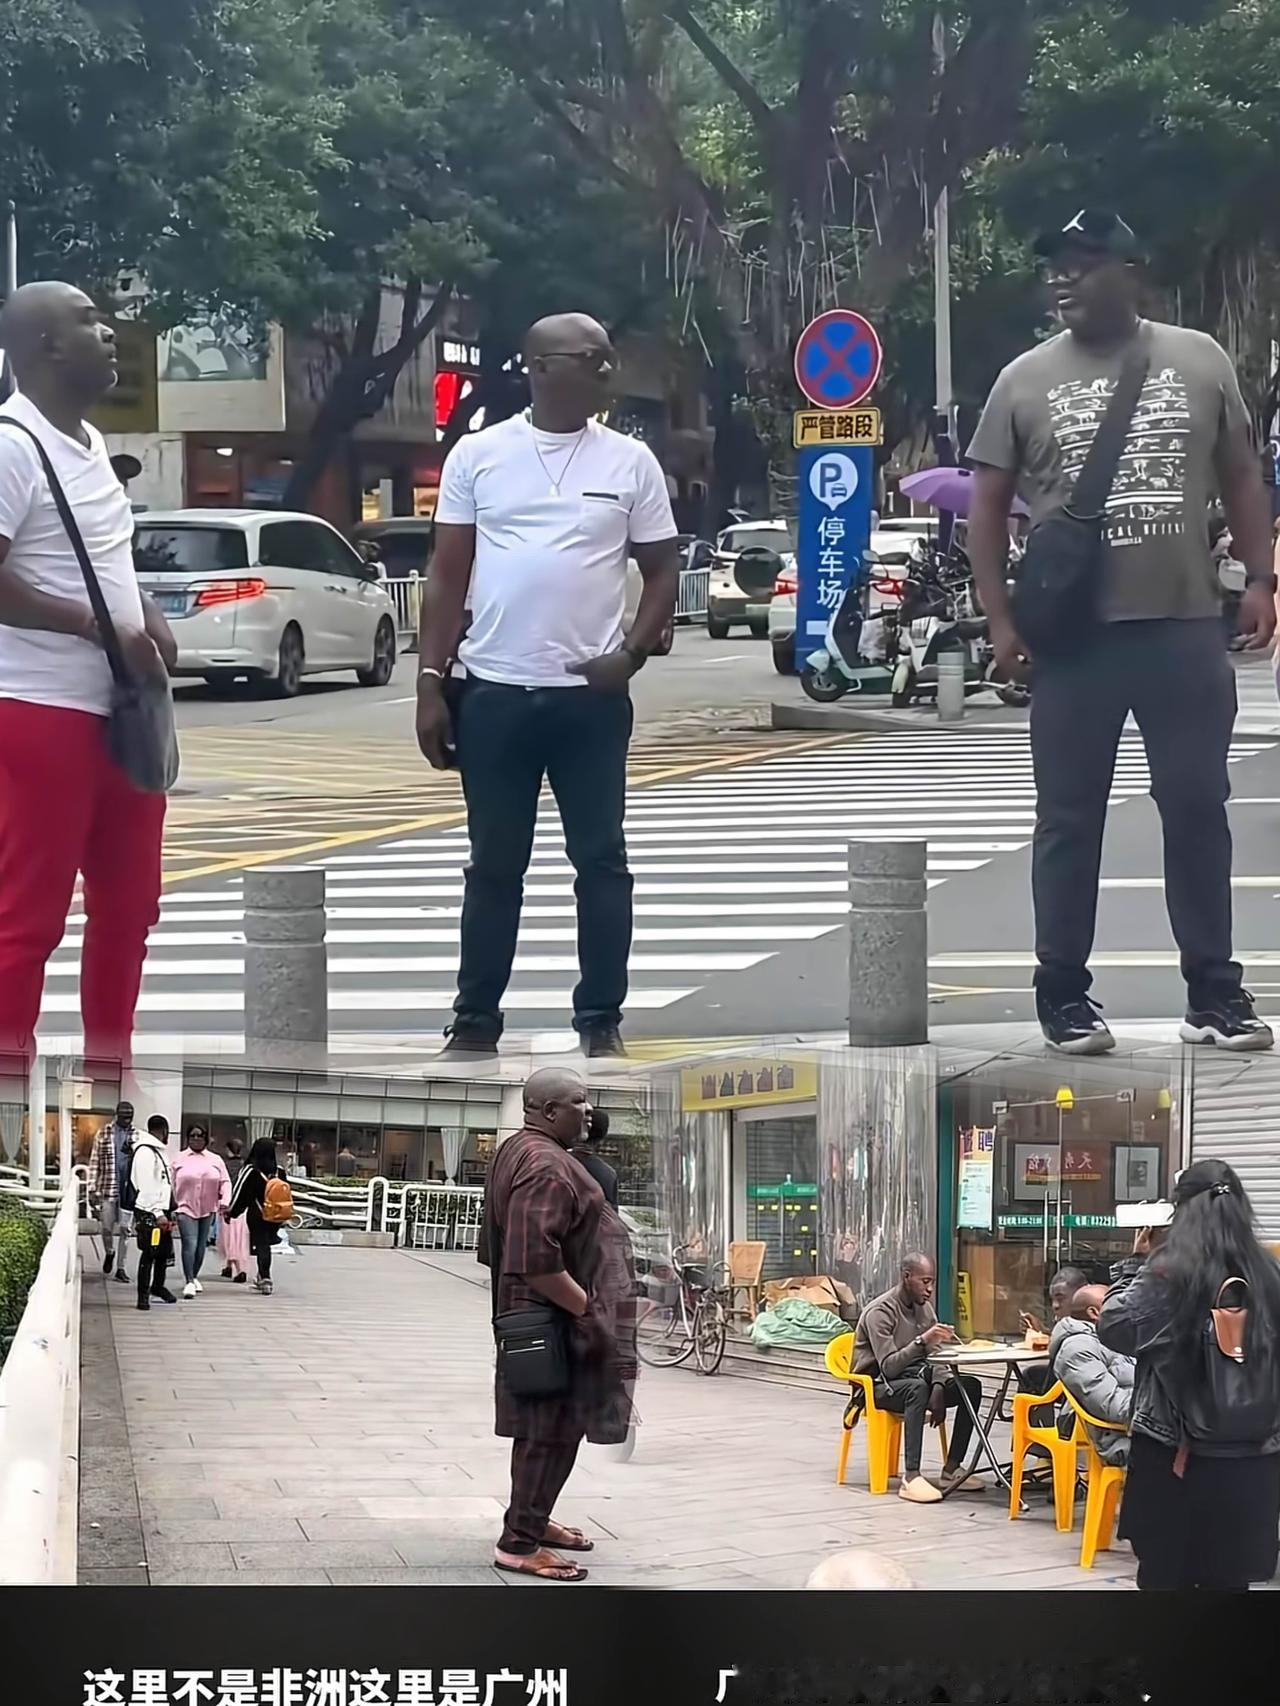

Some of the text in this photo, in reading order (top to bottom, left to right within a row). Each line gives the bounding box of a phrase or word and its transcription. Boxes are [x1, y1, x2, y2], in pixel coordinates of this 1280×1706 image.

[800, 414, 873, 440] 严管路段
[819, 462, 842, 498] P
[817, 516, 845, 609] 停车场
